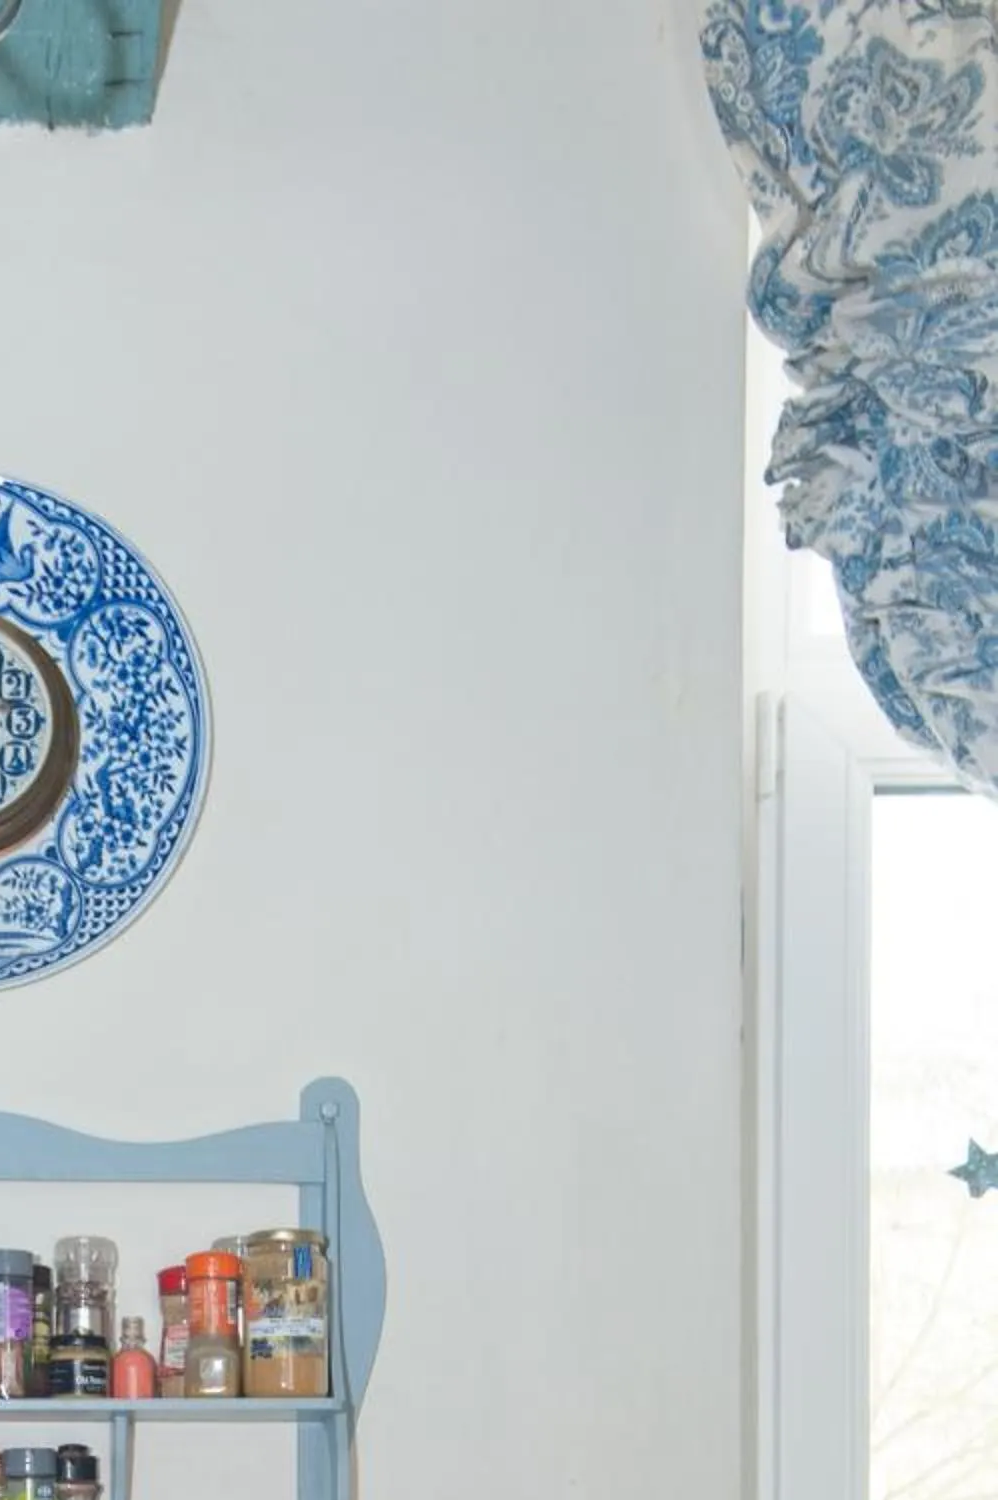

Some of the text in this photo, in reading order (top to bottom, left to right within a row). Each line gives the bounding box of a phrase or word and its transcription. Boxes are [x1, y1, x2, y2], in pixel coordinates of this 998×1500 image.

[5, 673, 22, 697] 2
[16, 710, 30, 734] 3
[8, 748, 24, 772] 4
